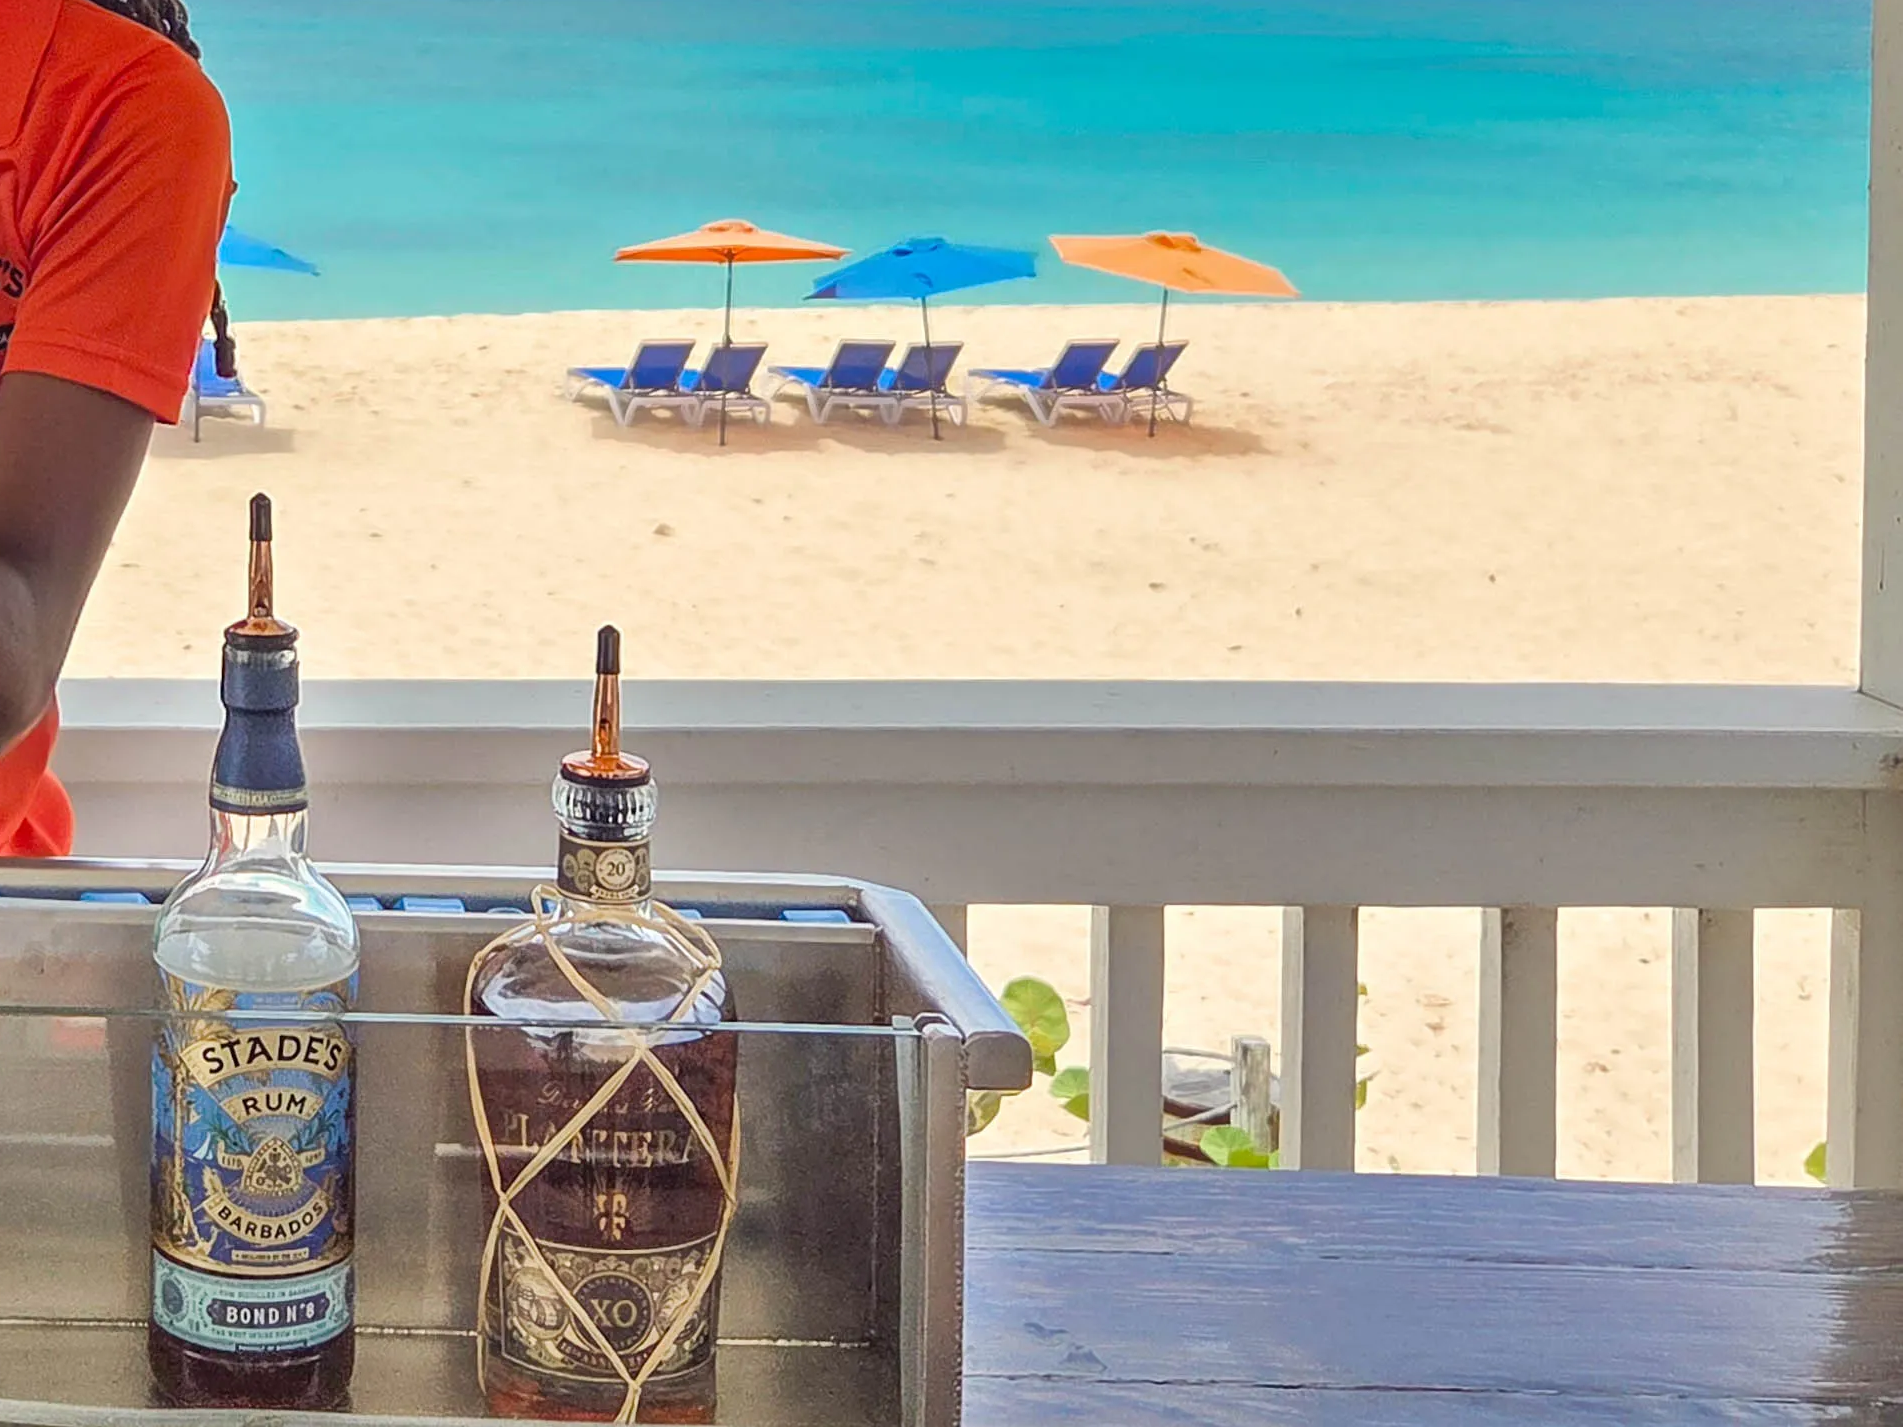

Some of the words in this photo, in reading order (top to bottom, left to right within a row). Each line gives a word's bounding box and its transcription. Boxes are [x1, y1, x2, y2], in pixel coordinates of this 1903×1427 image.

[607, 861, 626, 877] 20
[202, 1034, 343, 1074] STADE'S
[242, 1092, 307, 1116] RUM
[217, 1201, 323, 1239] BARBADOS
[226, 1306, 280, 1325] BOND
[590, 1298, 638, 1328] XO
